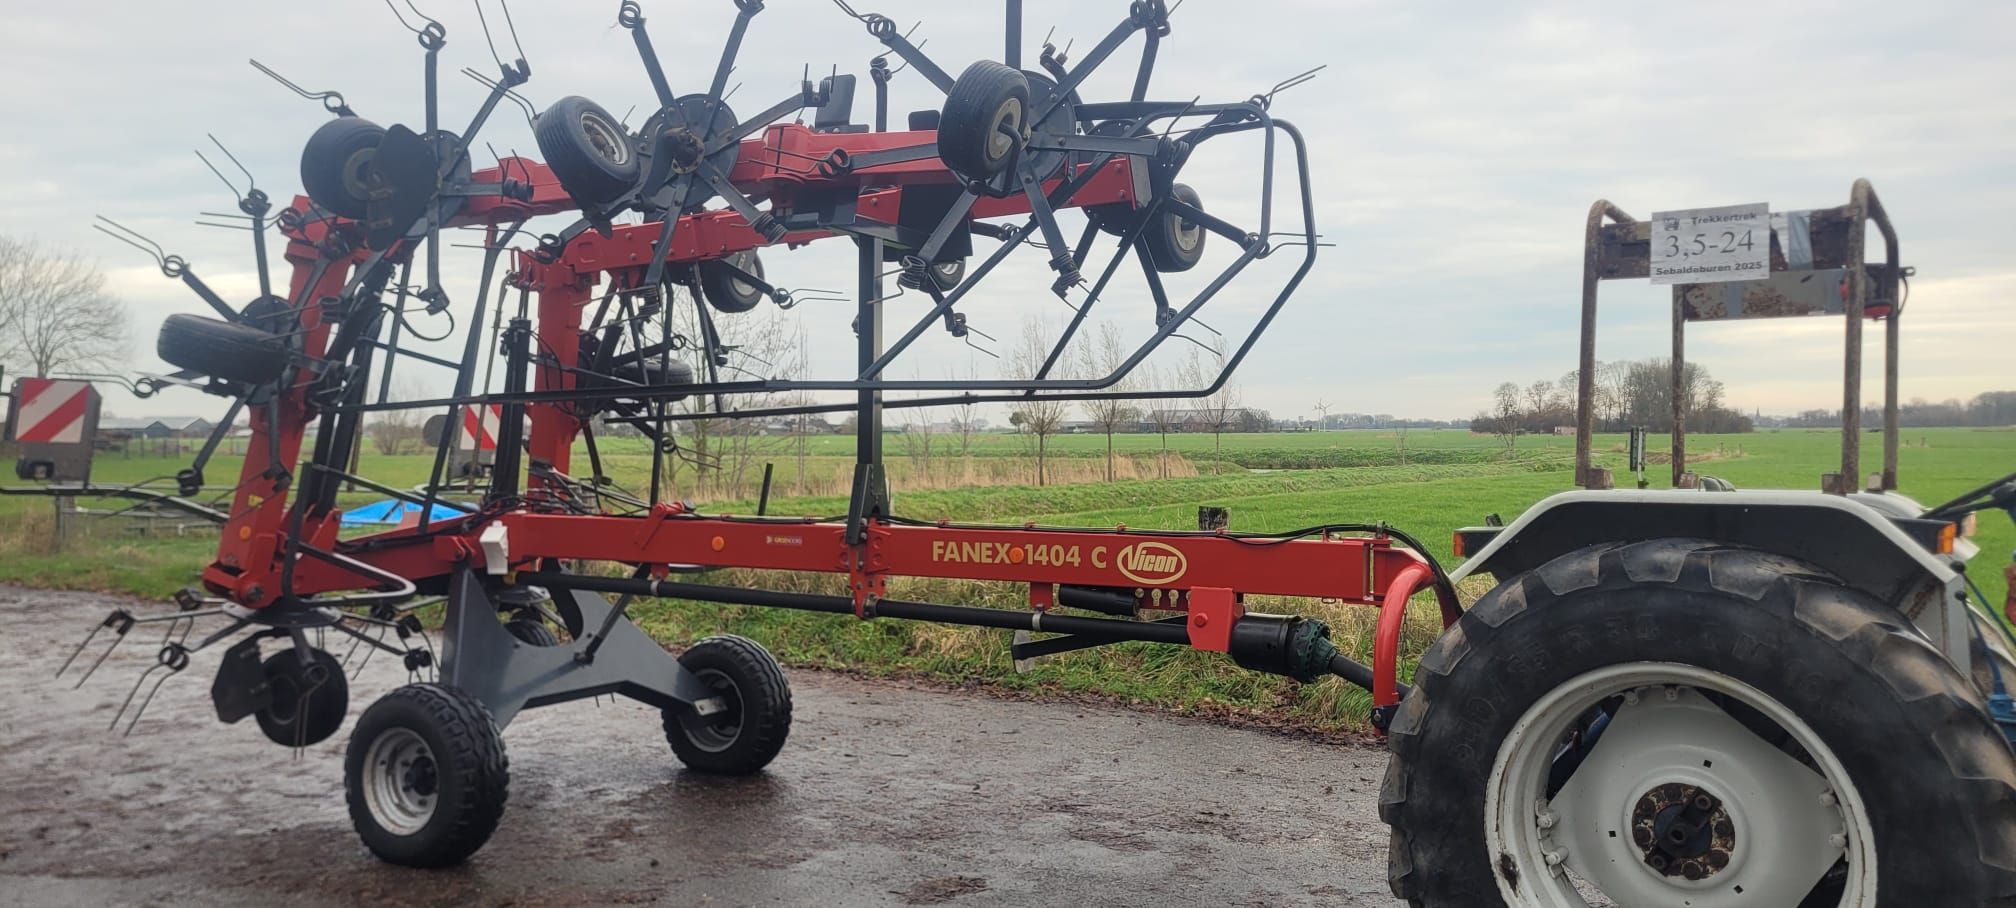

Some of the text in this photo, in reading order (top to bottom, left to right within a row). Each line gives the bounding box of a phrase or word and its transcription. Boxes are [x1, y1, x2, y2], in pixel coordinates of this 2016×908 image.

[1690, 212, 1757, 225] Trekkertrek
[1665, 229, 1755, 261] 3,5-24
[1734, 261, 1763, 272] 2025
[932, 540, 1107, 569] FANEX 1404 C
[1124, 543, 1179, 574] Vicon
